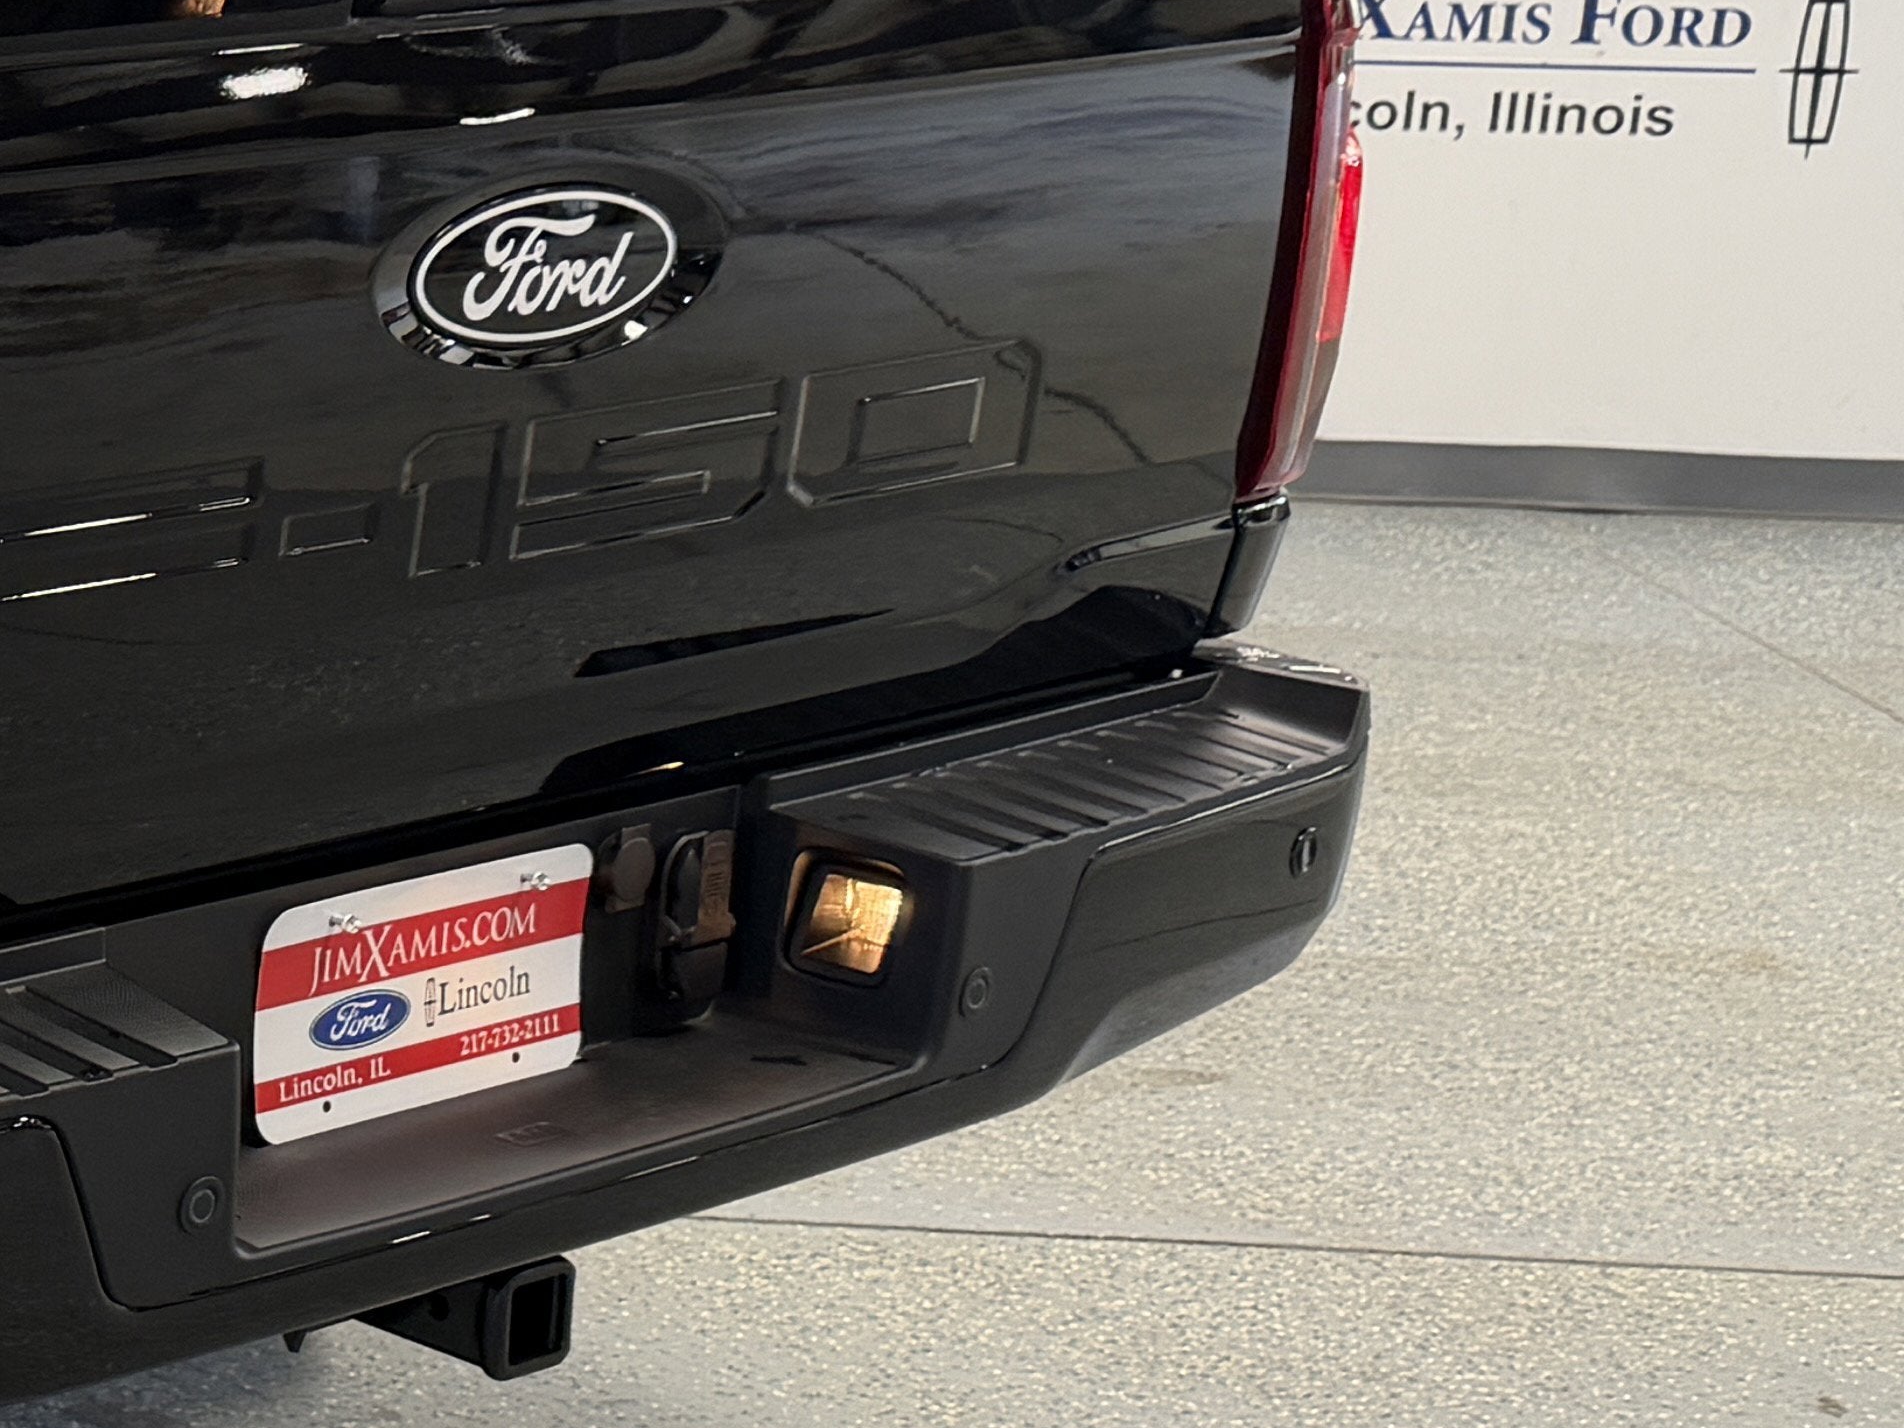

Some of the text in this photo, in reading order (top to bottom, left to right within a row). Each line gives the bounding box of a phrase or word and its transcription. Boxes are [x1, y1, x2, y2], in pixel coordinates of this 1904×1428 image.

[1488, 90, 1675, 136] Illinois
[462, 214, 634, 321] Ford
[438, 965, 531, 1016] Lincoln
[330, 999, 392, 1042] Ford
[460, 1013, 560, 1056] 217-732-2111
[369, 1056, 391, 1079] IL
